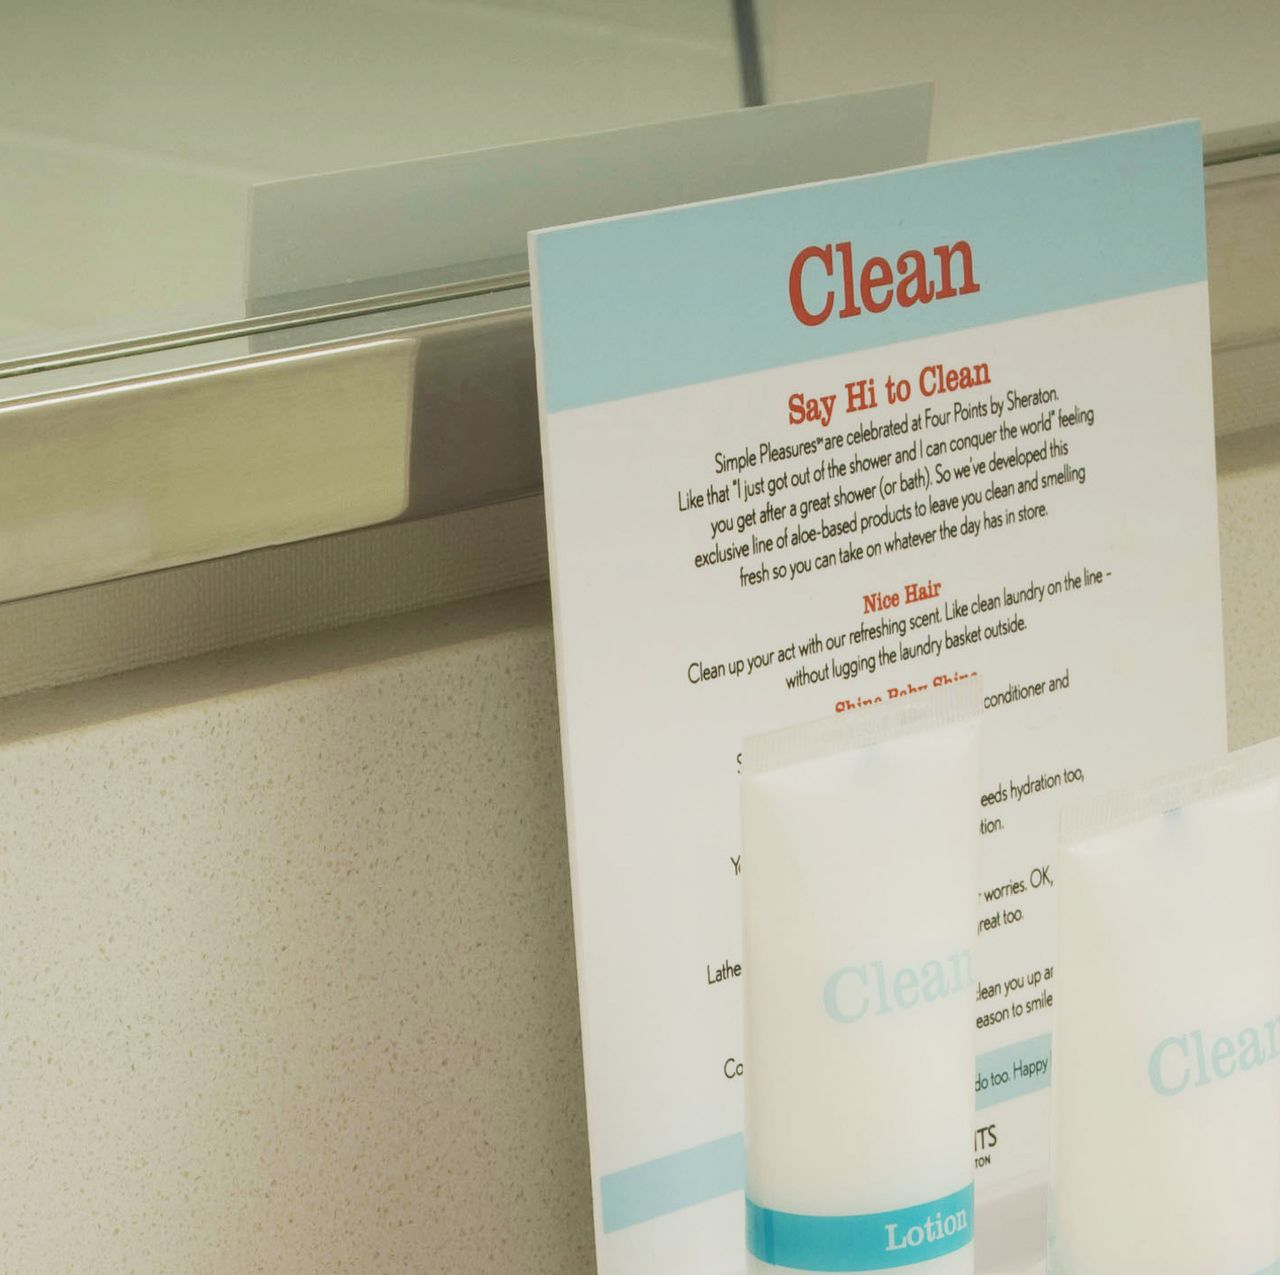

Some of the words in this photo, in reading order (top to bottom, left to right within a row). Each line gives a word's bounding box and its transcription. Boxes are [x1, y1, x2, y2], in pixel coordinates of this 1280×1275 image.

[788, 238, 981, 328] Clean
[788, 393, 836, 426] Say
[845, 378, 877, 413] Hi
[885, 376, 911, 404] to
[920, 362, 991, 397] Clean
[715, 447, 756, 474] Simple
[825, 434, 843, 450] are
[846, 413, 908, 446] celebrated
[911, 415, 922, 431] at
[925, 408, 951, 429] Four
[954, 402, 988, 422] Points
[991, 395, 1004, 417] by
[1007, 388, 1059, 412] Sheraton.
[678, 491, 704, 511] Like
[707, 485, 729, 505] that
[744, 478, 765, 503] just
[768, 474, 788, 496] got
[791, 470, 810, 487] out
[814, 460, 825, 482] of
[828, 459, 846, 479] the
[850, 453, 892, 474] shower
[895, 440, 917, 465] and
[926, 441, 947, 457] can
[950, 429, 997, 451] conquer
[1000, 421, 1018, 441] the
[1058, 405, 1094, 426] feeling
[711, 518, 733, 539] you
[737, 512, 756, 533] get
[760, 502, 786, 523] after
[790, 502, 797, 516] a
[800, 495, 830, 519] great
[834, 486, 876, 507] shower
[879, 475, 897, 500] (or
[936, 464, 951, 483] So
[989, 442, 1047, 472] developed
[1050, 438, 1069, 458] this
[695, 543, 749, 568] exclusive
[753, 535, 773, 555] line
[776, 527, 788, 550] of
[791, 512, 857, 546] aloe-based
[861, 502, 912, 534] products
[915, 502, 926, 517] to
[929, 495, 958, 514] leave
[962, 491, 982, 511] you
[985, 481, 1014, 500] clean
[1018, 471, 1038, 493] and
[1041, 464, 1086, 488] smelling
[740, 562, 769, 587] fresh
[773, 564, 787, 579] so
[790, 559, 811, 580] you
[815, 552, 836, 570] can
[839, 542, 863, 564] take
[867, 543, 881, 557] on
[884, 529, 936, 552] whatever
[940, 520, 957, 540] the
[961, 516, 981, 537] day
[984, 511, 1002, 531] has
[1006, 509, 1015, 524] in
[1019, 503, 1048, 521] store.
[863, 592, 899, 614] Nice
[905, 580, 941, 605] Hair
[688, 661, 725, 684] Clean
[729, 659, 744, 677] up
[747, 651, 774, 675] your
[777, 643, 795, 662] act
[798, 634, 822, 657] with
[826, 635, 845, 650] our
[849, 617, 906, 645] refreshing
[910, 608, 942, 630] scent.
[945, 600, 968, 621] Like
[971, 594, 1001, 614] clean
[1003, 580, 1045, 607] laundry
[1048, 581, 1062, 595] on
[1064, 570, 1081, 590] the
[1084, 567, 1102, 587] line
[786, 663, 829, 689] without
[832, 655, 876, 680] lugging
[879, 646, 897, 666] the
[899, 635, 942, 661] laundry
[945, 625, 982, 649] basket
[984, 613, 1027, 639] outside.
[984, 681, 1046, 709] conditioner
[1049, 669, 1069, 692] and
[981, 783, 1007, 807] eeds
[1010, 774, 1061, 801] hydration
[984, 880, 1027, 902] worries.
[1030, 865, 1053, 888] OK,
[978, 912, 1000, 936] reat
[707, 960, 742, 985] Lathe
[823, 949, 976, 1024] Clean
[1004, 976, 1024, 997] you
[1027, 970, 1041, 986] up
[976, 1007, 1009, 1029] eason
[1012, 1003, 1023, 1017] to
[1013, 1058, 1048, 1080] Happy
[884, 1209, 968, 1251] Lotion
